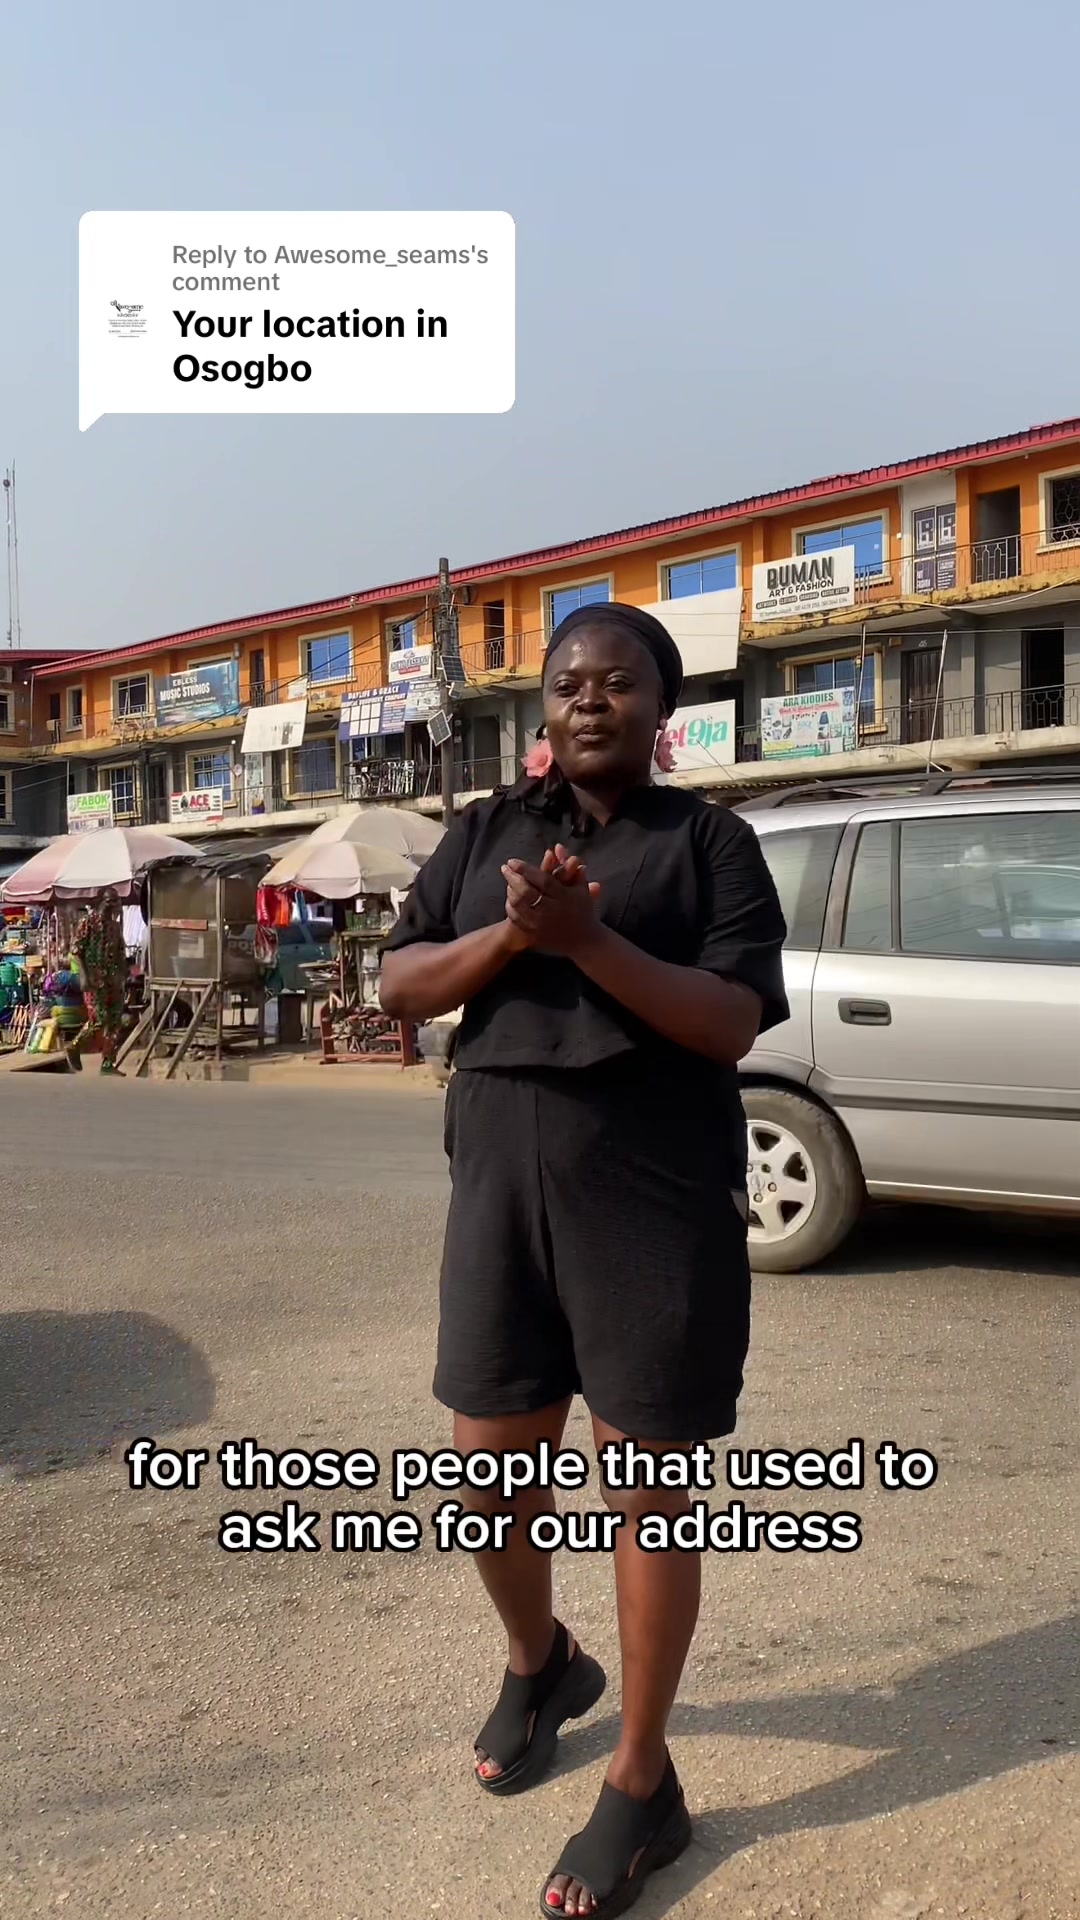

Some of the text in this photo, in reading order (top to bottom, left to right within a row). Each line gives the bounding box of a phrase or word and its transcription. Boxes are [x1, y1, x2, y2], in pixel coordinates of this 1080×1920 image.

[768, 587, 786, 598] ART
[795, 579, 834, 593] FASHION
[160, 682, 211, 702] MUSIC STUDIOS
[664, 715, 728, 748] et9ja
[190, 794, 209, 807] ACE
